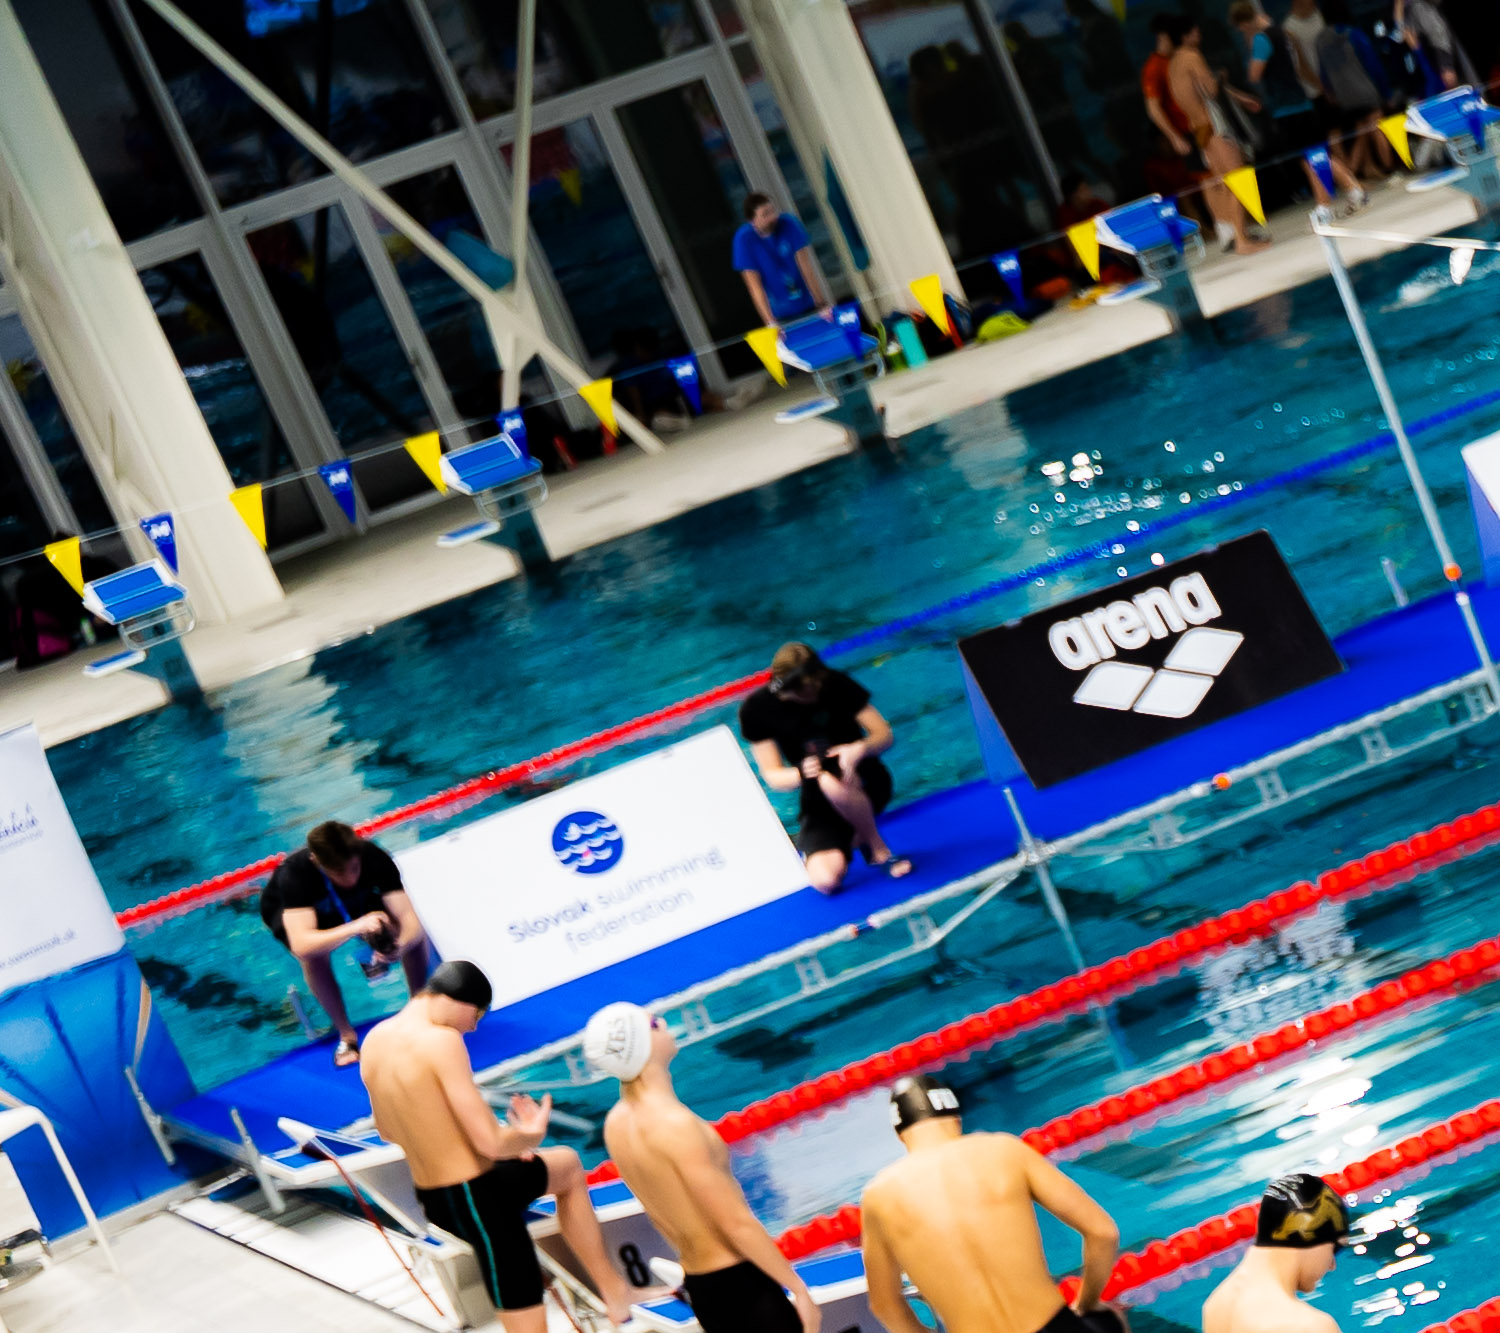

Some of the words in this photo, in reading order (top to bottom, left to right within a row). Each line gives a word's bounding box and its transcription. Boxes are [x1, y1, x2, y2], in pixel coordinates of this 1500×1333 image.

[1048, 571, 1222, 671] arena
[564, 887, 695, 953] federation
[619, 1243, 650, 1288] 8
